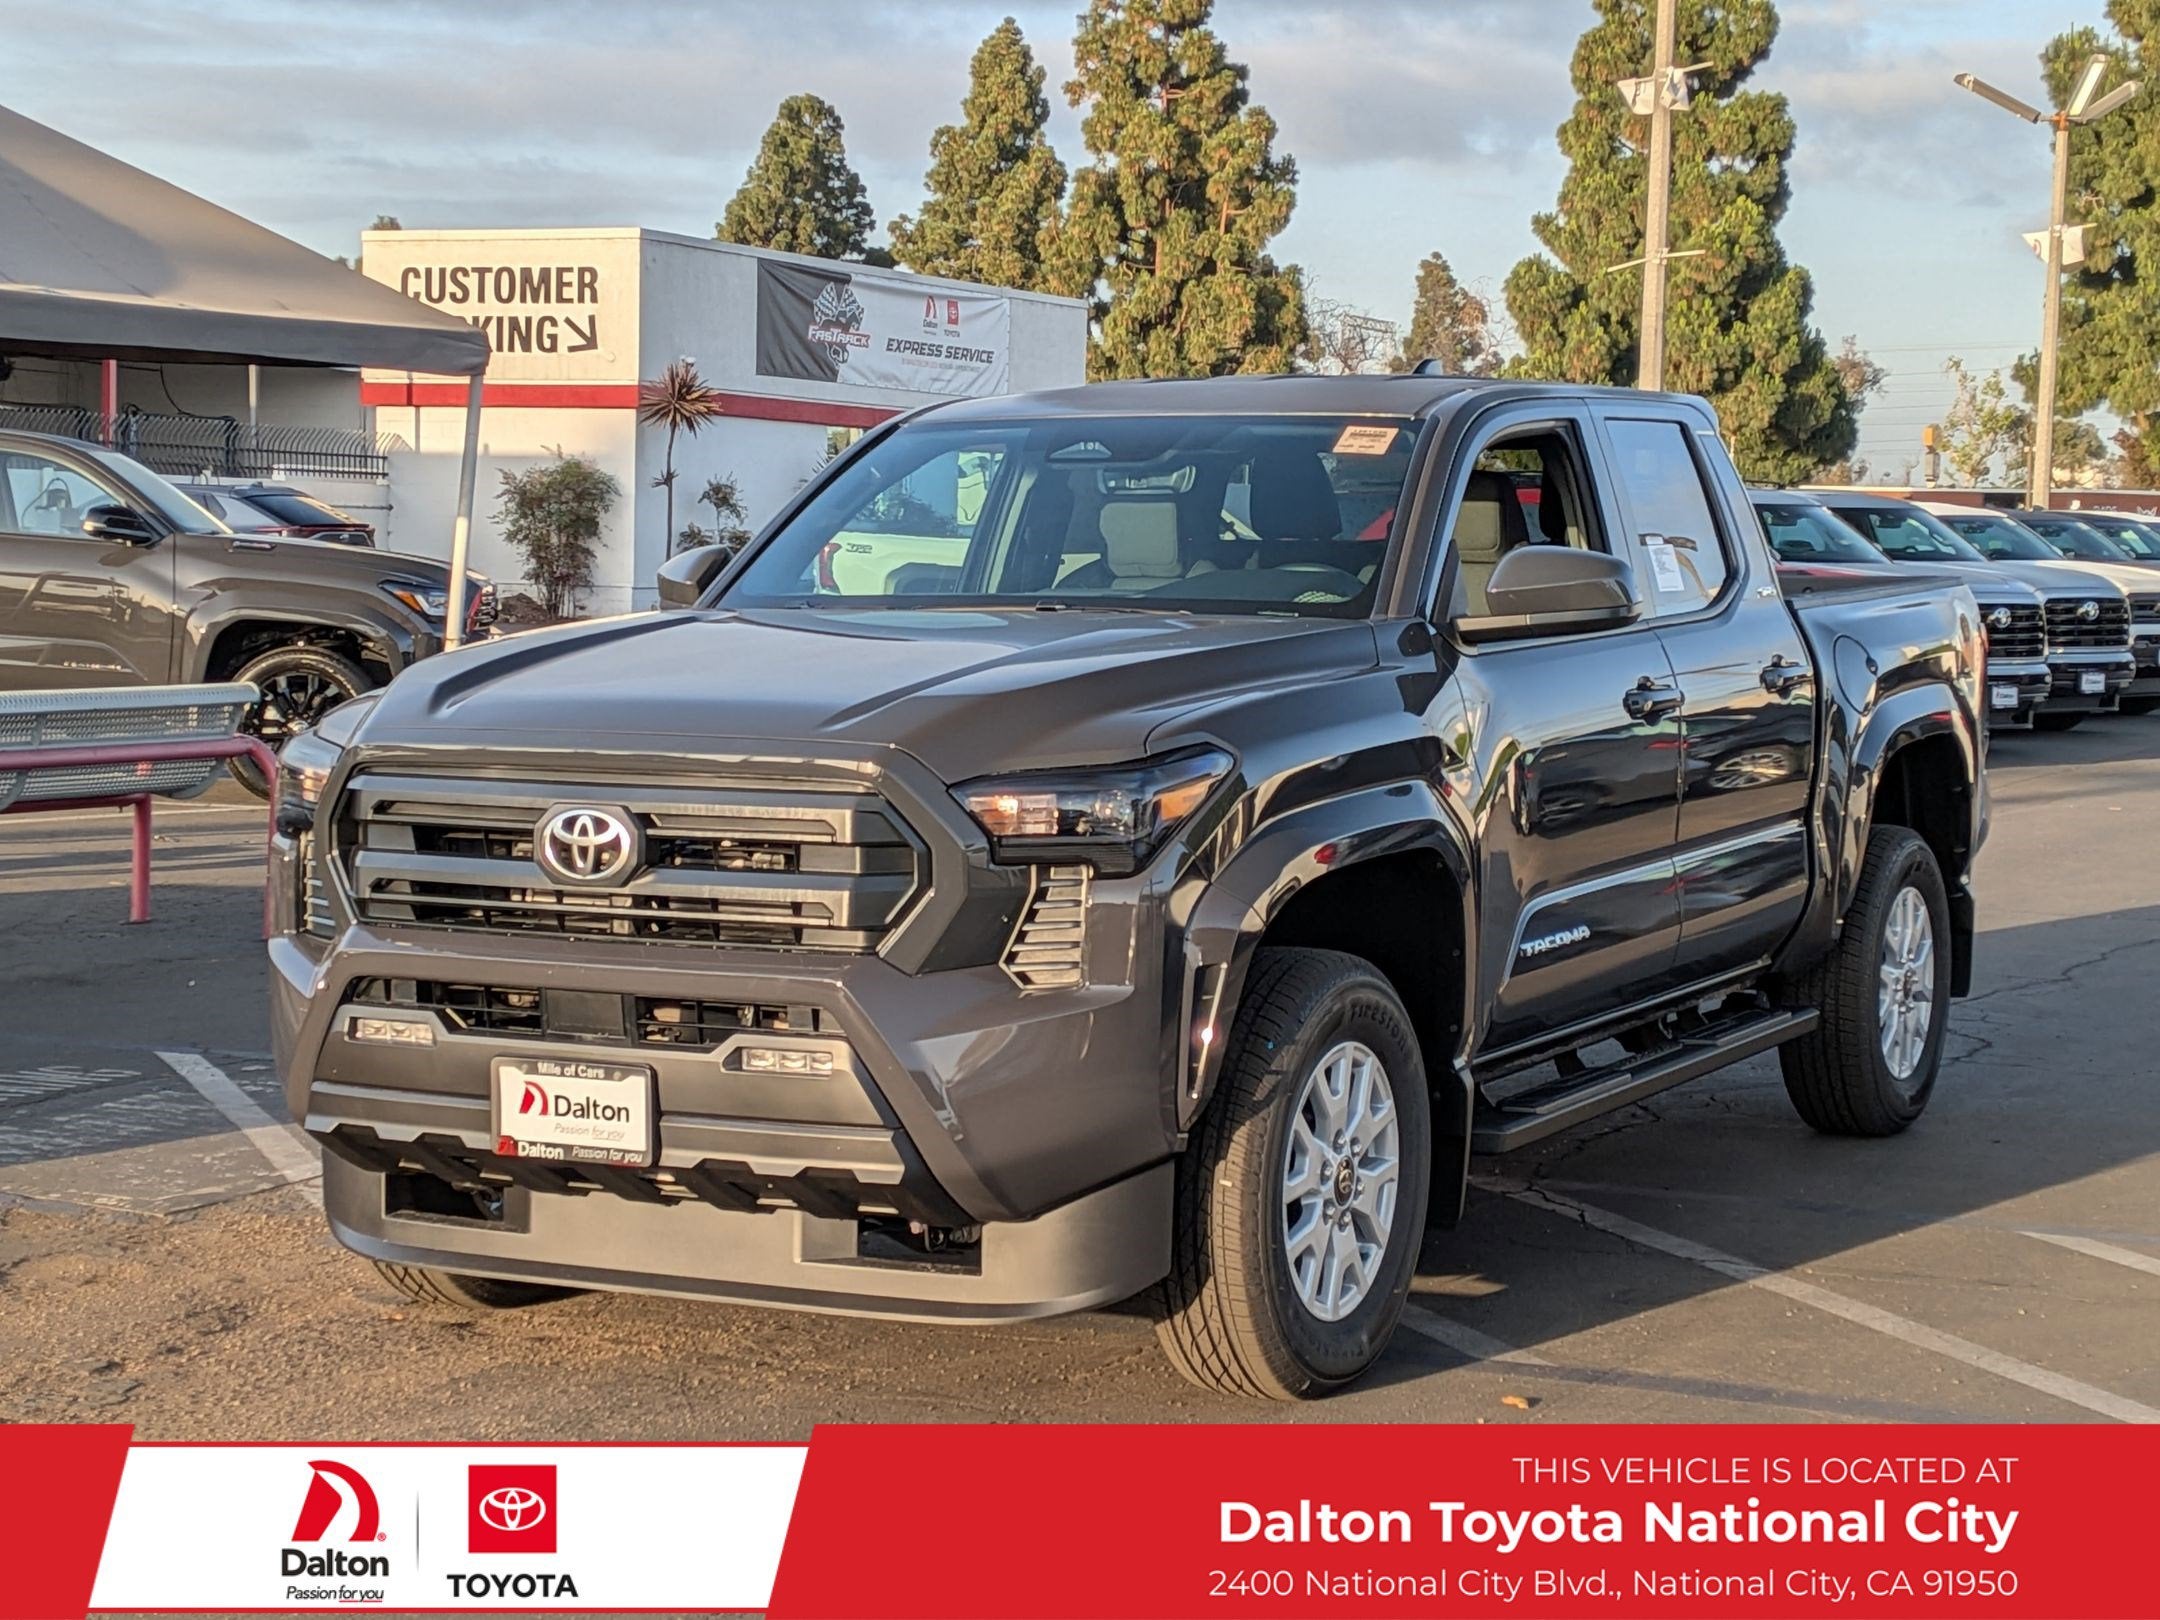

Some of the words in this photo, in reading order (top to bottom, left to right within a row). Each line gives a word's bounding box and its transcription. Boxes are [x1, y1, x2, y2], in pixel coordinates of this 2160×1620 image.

[401, 266, 598, 304] CUSTOMER
[886, 338, 943, 358] EXPRESS
[945, 345, 995, 364] SERVICE
[1520, 925, 1591, 957] TACOMA
[537, 1061, 561, 1076] Mile
[563, 1065, 576, 1076] of
[577, 1066, 606, 1079] Cars
[554, 1094, 630, 1123] Dalton
[554, 1123, 590, 1136] Passion
[591, 1126, 606, 1140] for
[606, 1130, 625, 1141] you
[518, 1141, 565, 1160] Dalton
[572, 1146, 608, 1160] Passion
[608, 1149, 624, 1161] for
[624, 1152, 644, 1164] you
